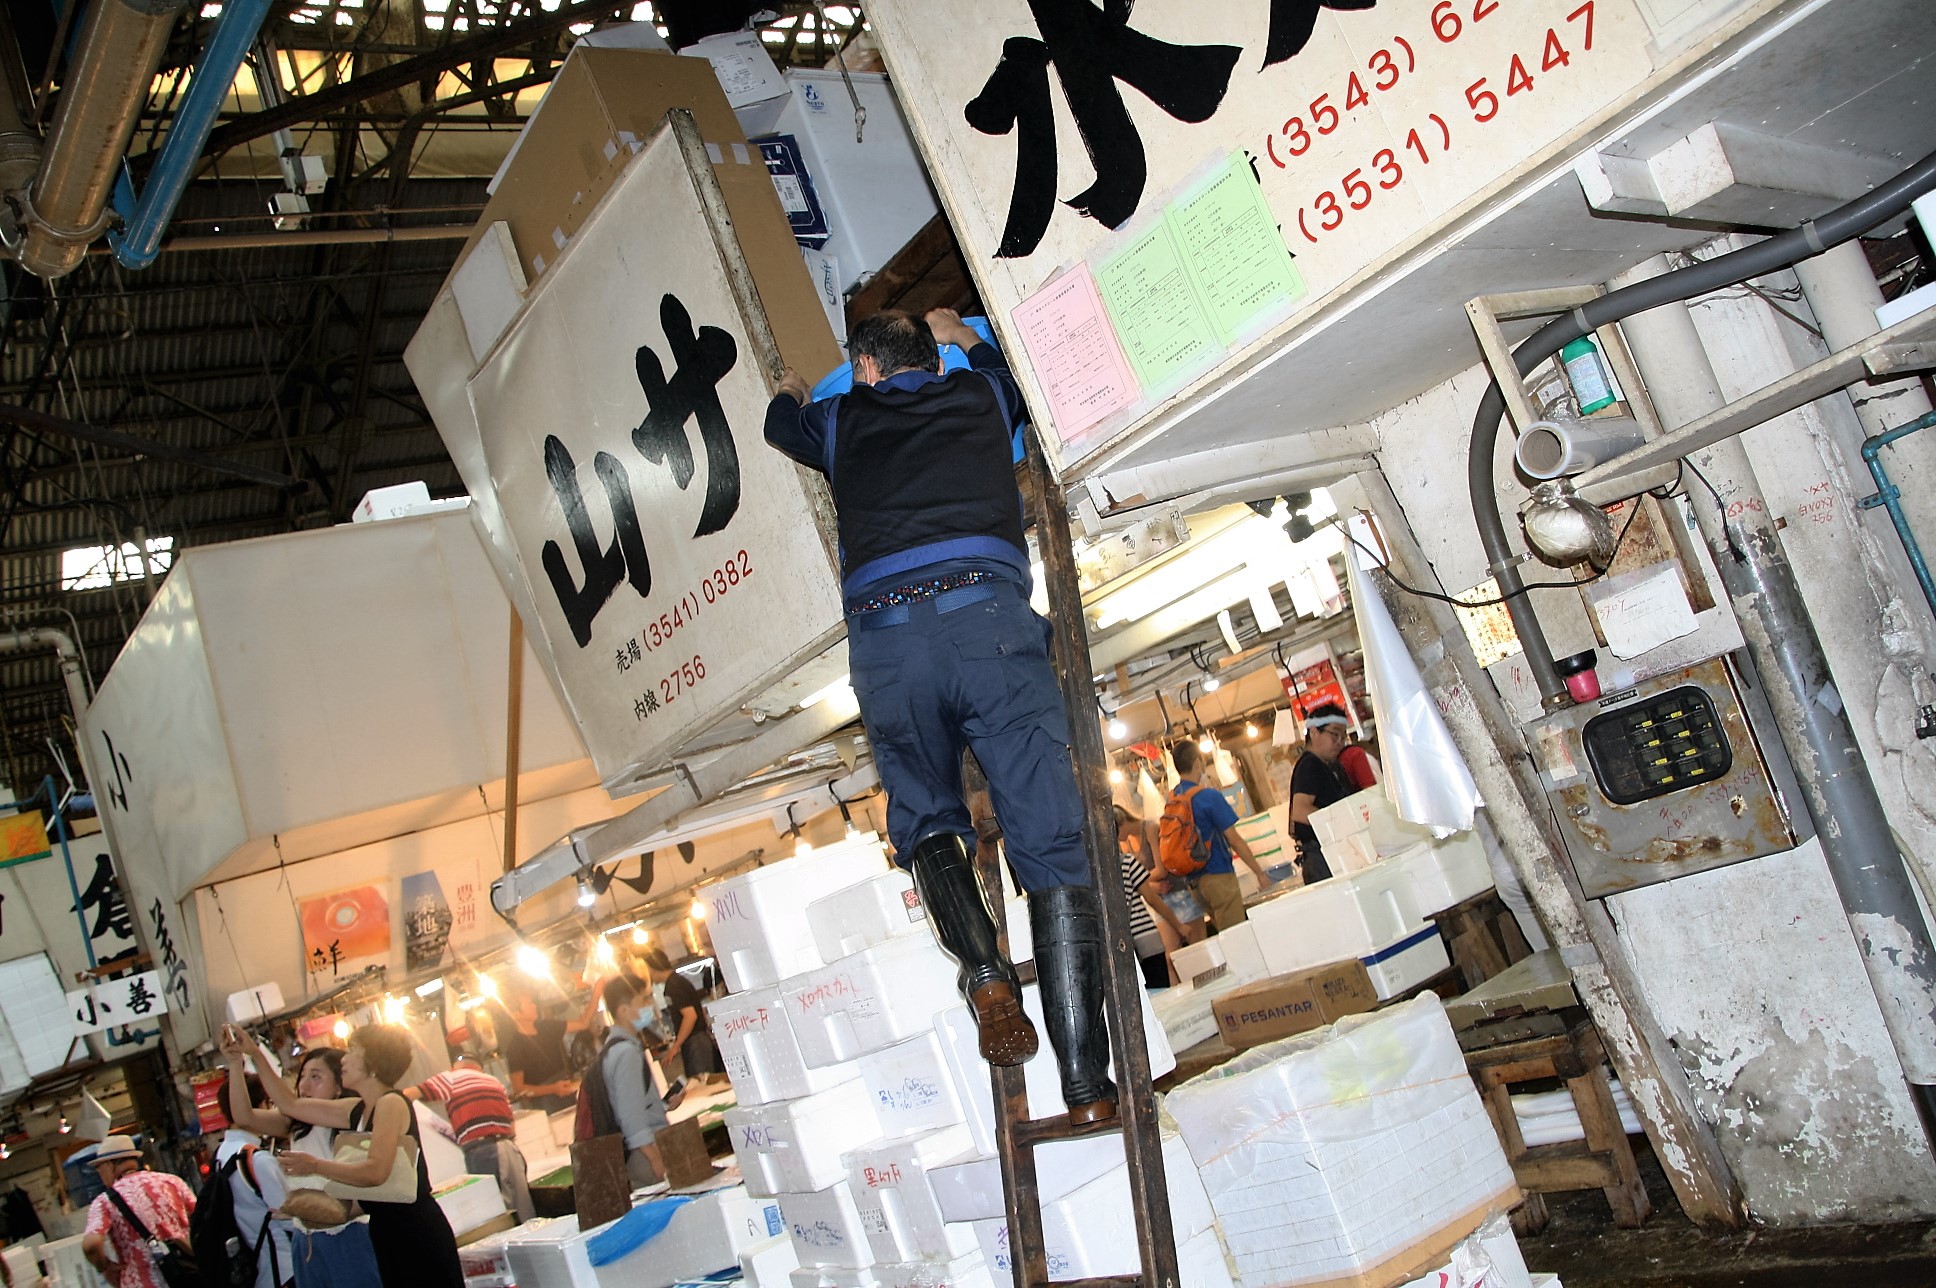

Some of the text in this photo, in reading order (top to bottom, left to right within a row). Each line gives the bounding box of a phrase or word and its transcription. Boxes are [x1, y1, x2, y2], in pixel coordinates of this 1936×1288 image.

[1266, 35, 1415, 169] (3543)
[1298, 0, 1594, 243] (3531) 5447
[615, 548, 753, 675] 売場 (3541) 0382
[634, 654, 707, 722] 内線 2756
[77, 977, 157, 1027] 小善
[1240, 1000, 1314, 1026] PESANTAR
